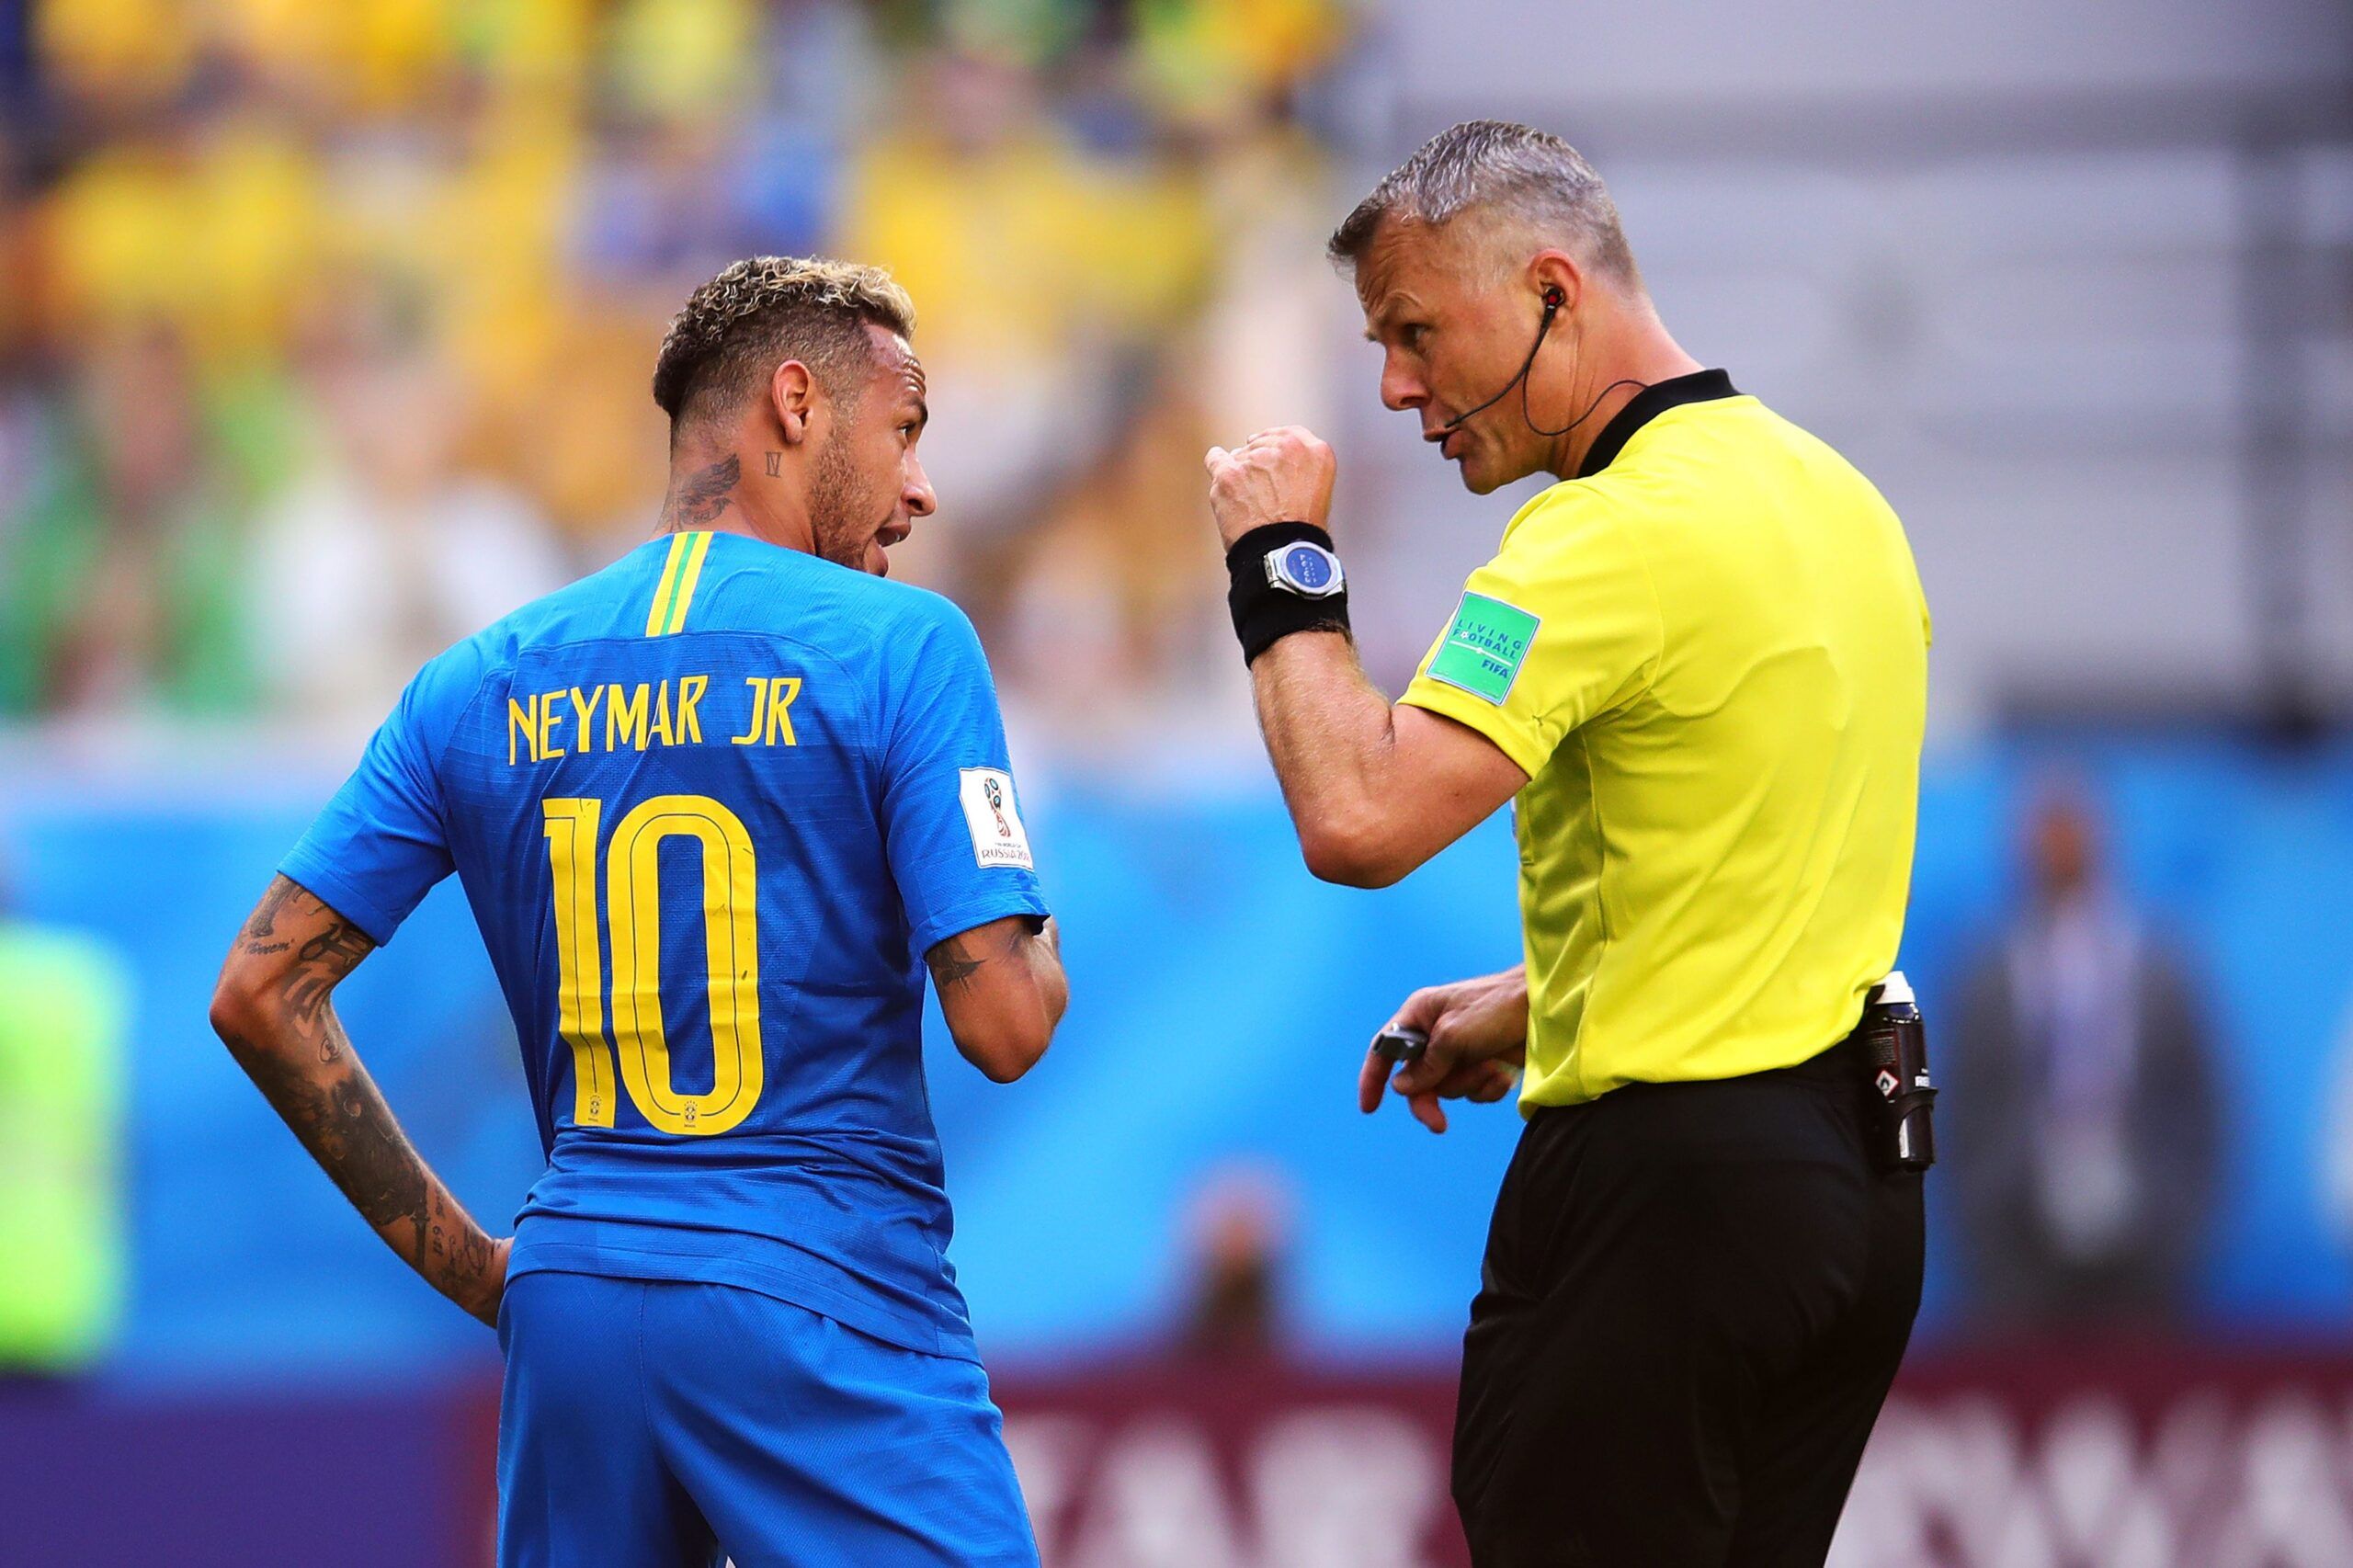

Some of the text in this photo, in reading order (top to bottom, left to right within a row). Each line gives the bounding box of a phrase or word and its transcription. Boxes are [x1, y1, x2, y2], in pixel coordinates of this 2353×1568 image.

[1458, 619, 1522, 650] LIVING
[1482, 659, 1509, 678] FIFA
[507, 675, 801, 766] NEYMAR JR
[982, 848, 1016, 858] RUSSIA
[542, 794, 765, 1135] 10
